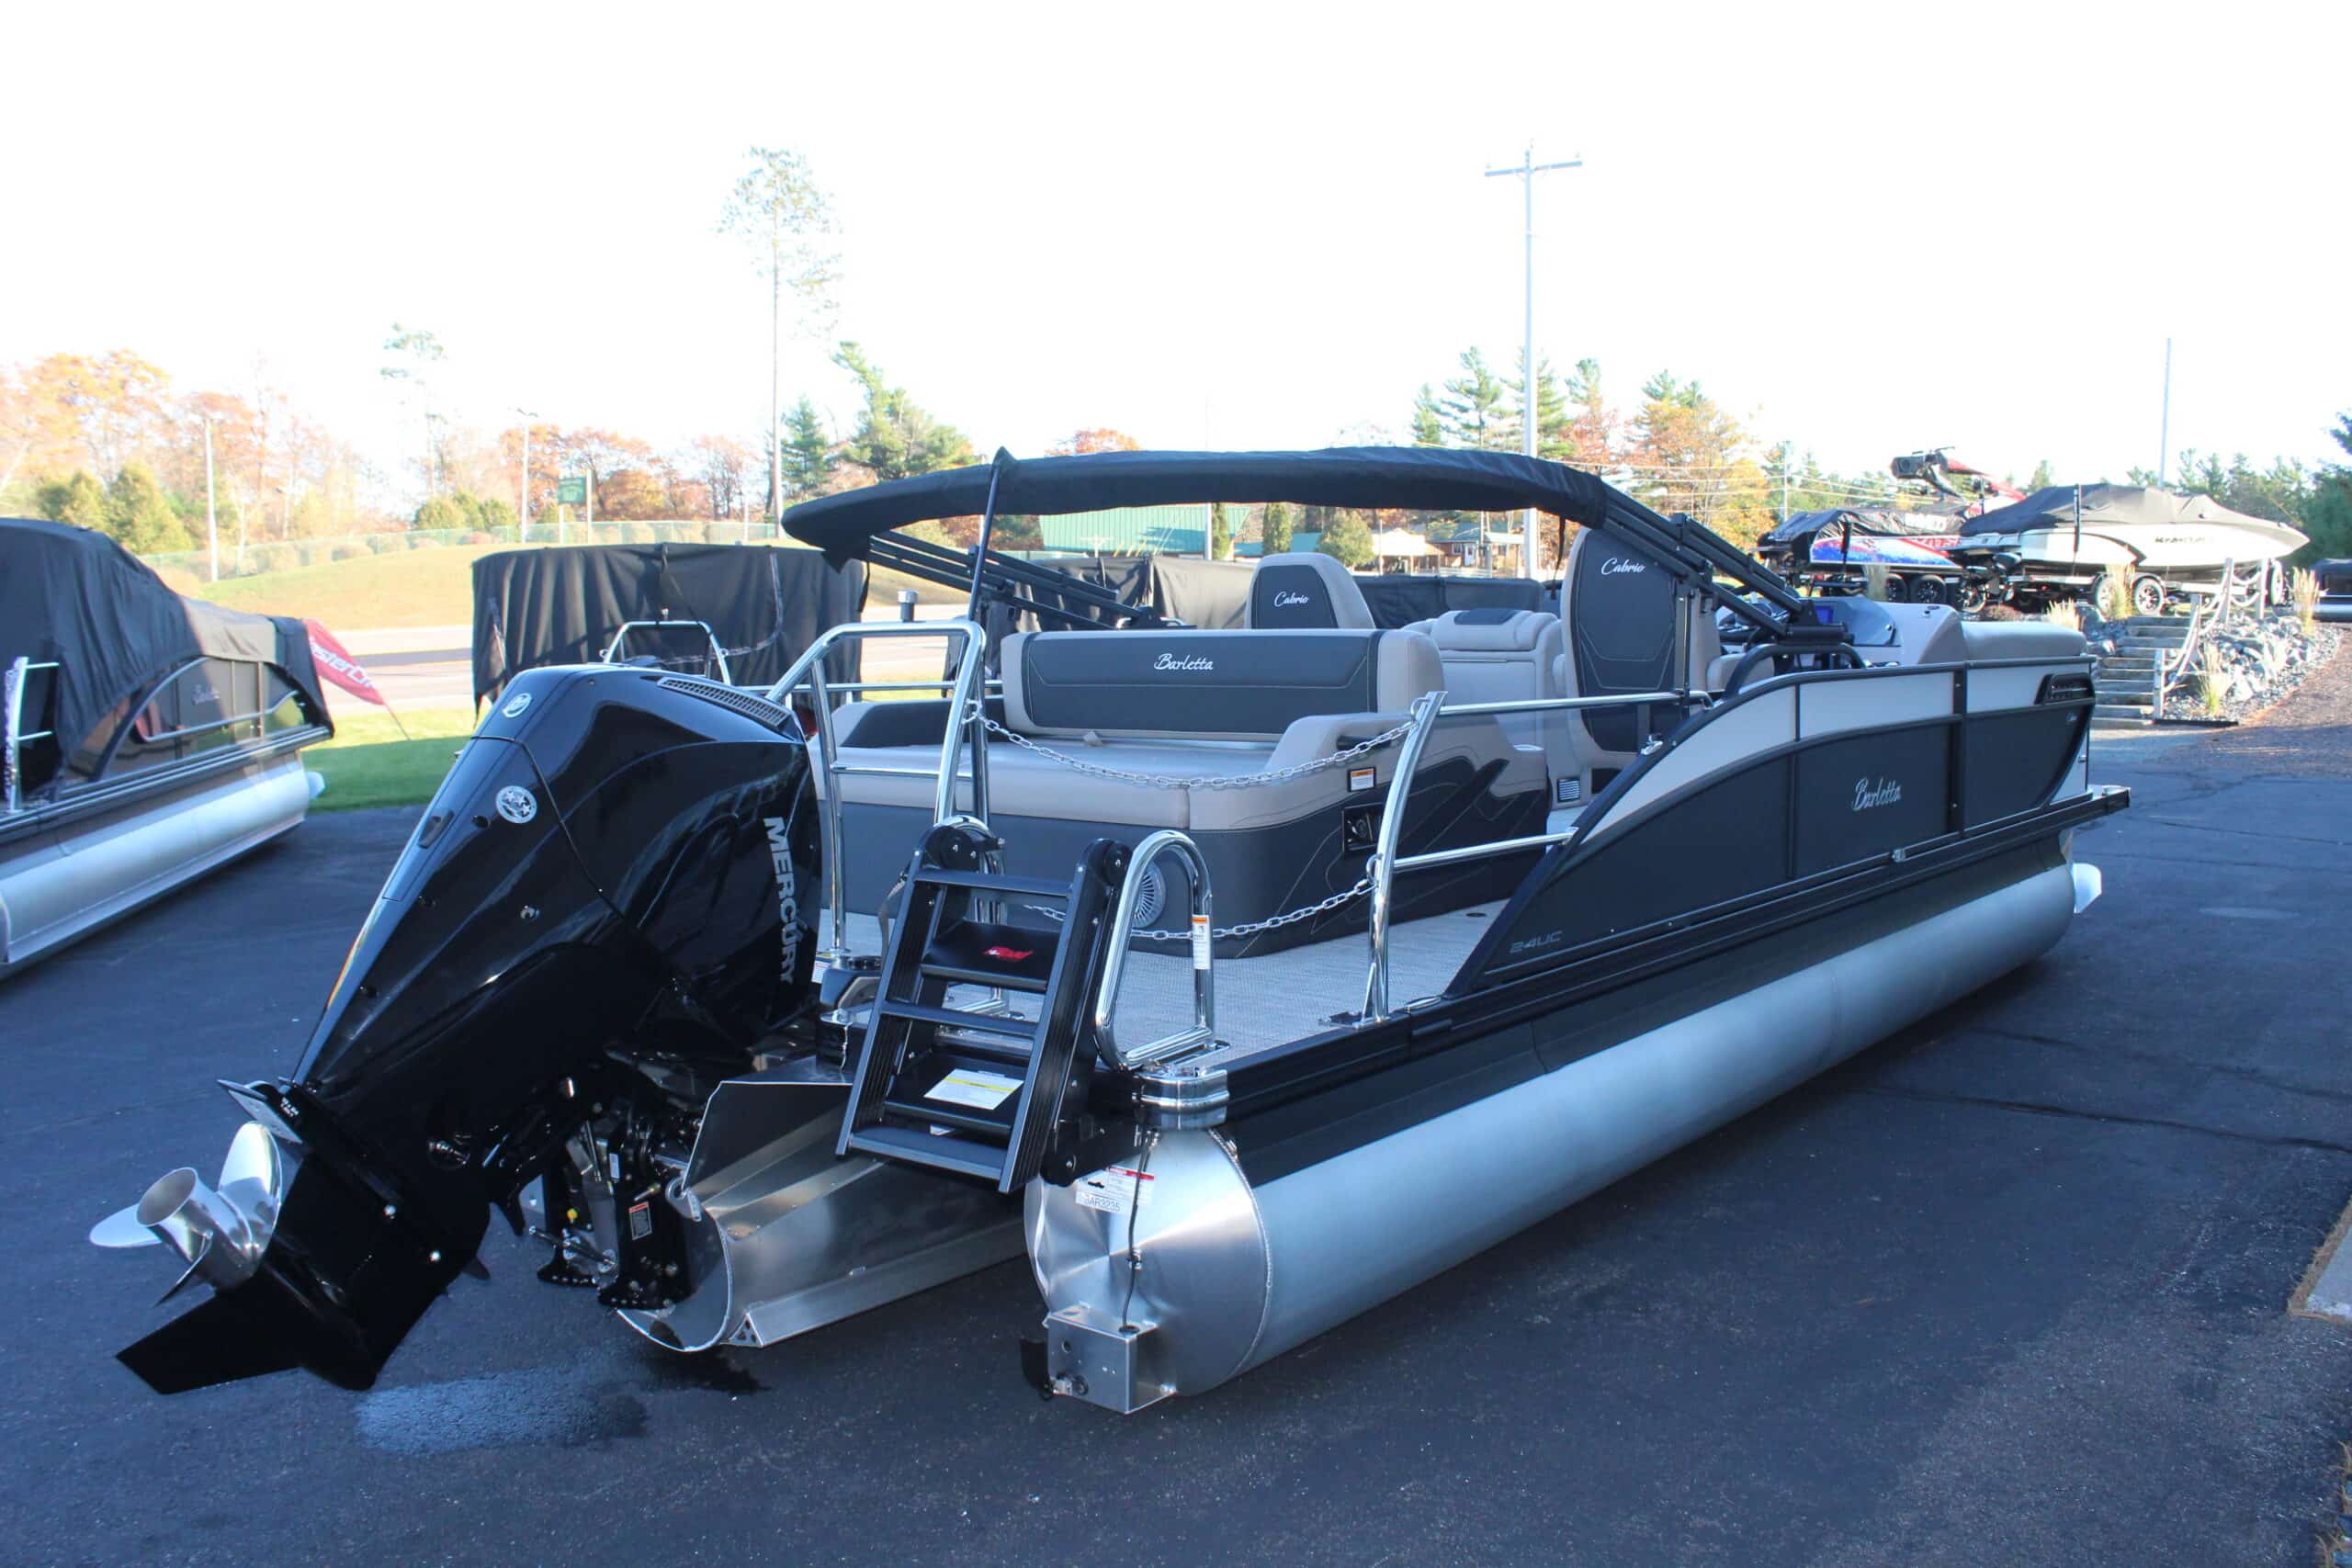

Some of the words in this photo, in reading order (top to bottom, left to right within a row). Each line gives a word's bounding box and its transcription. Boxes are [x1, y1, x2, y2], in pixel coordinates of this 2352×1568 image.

[1600, 558, 1645, 575] Cabrio
[1274, 591, 1309, 607] Cabrio
[1153, 653, 1214, 671] Barletta
[1852, 776, 1902, 811] Barletta
[763, 817, 798, 985] MERCURY
